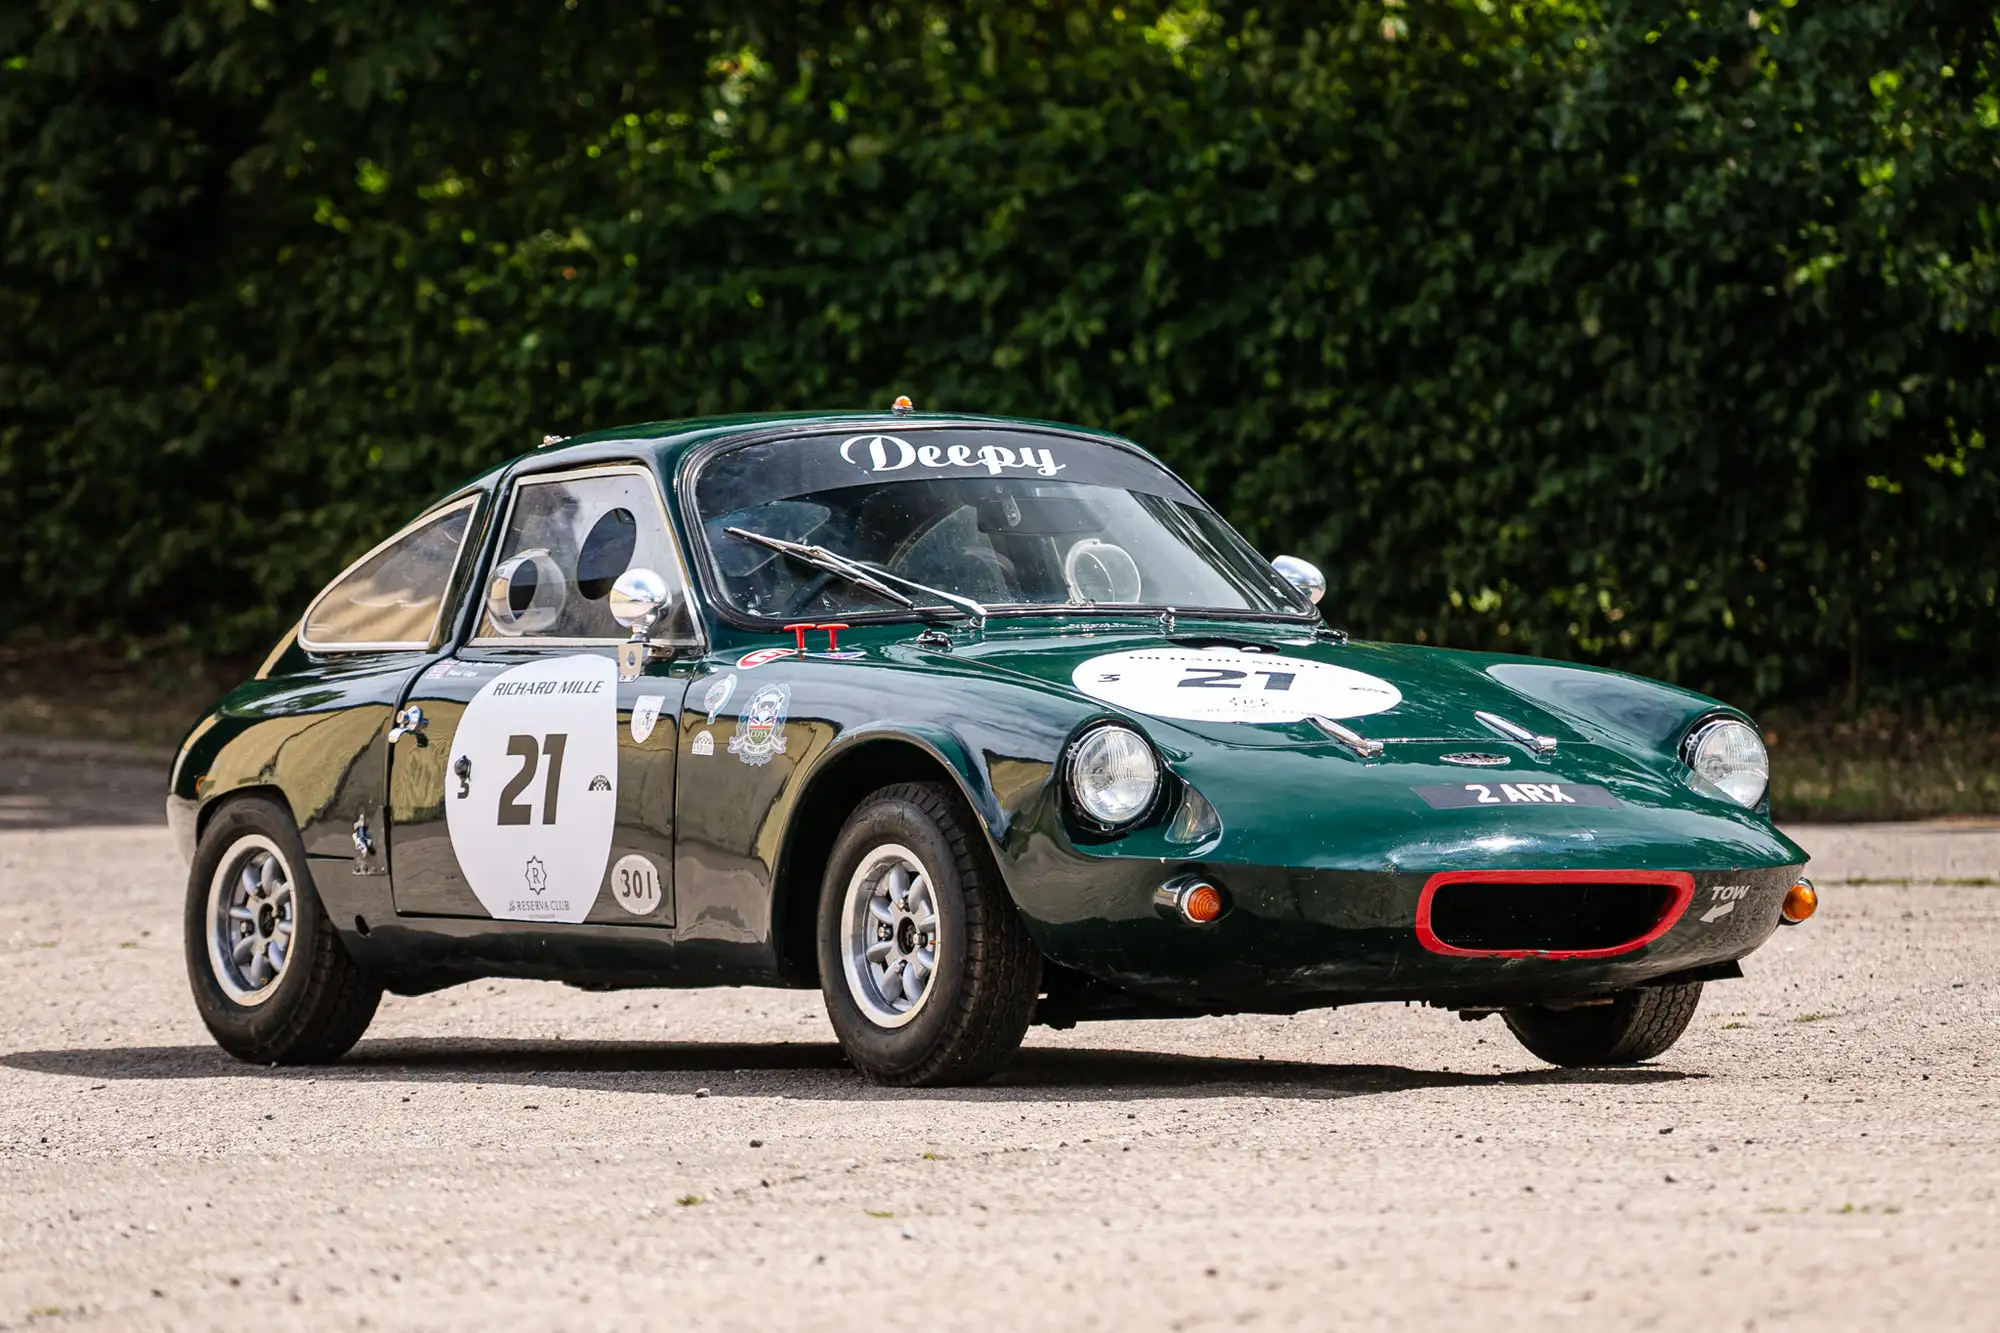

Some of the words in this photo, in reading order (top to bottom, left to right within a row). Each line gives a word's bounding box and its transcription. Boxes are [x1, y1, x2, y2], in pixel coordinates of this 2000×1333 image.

[839, 434, 1067, 477] Deepy
[492, 681, 558, 696] RICHARD
[558, 680, 605, 695] MILLE
[1177, 668, 1297, 691] 21
[750, 729, 768, 738] COYS
[497, 733, 568, 826] 21
[1465, 784, 1501, 804] 2
[1500, 783, 1576, 803] ARX
[531, 867, 542, 885] R
[620, 868, 653, 900] 301
[1711, 885, 1751, 901] TOW
[516, 900, 550, 912] RESERVA
[549, 900, 570, 912] CLUB
